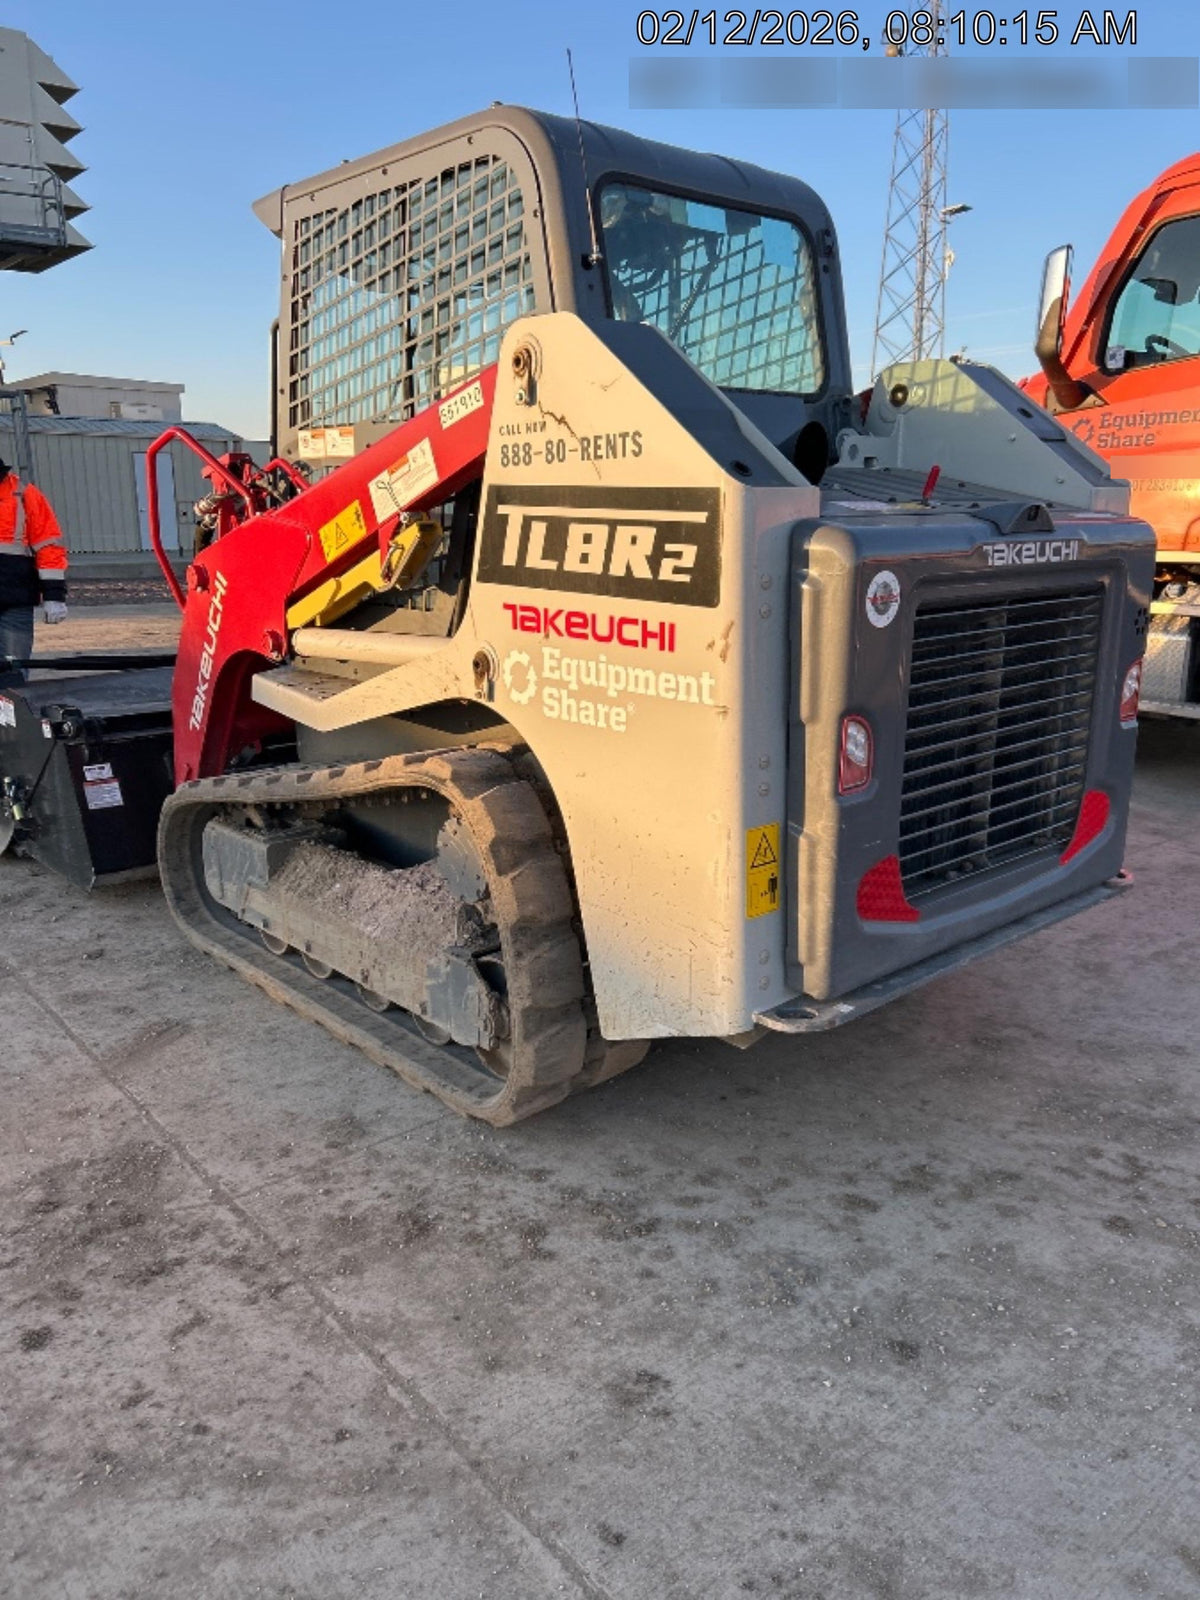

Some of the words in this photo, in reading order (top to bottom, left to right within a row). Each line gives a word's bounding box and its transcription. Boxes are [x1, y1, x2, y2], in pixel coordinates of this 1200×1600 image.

[499, 423, 521, 436] CALL
[526, 420, 547, 433] NOW
[500, 430, 643, 468] 888-80-RENTS
[541, 646, 715, 705] Equipment
